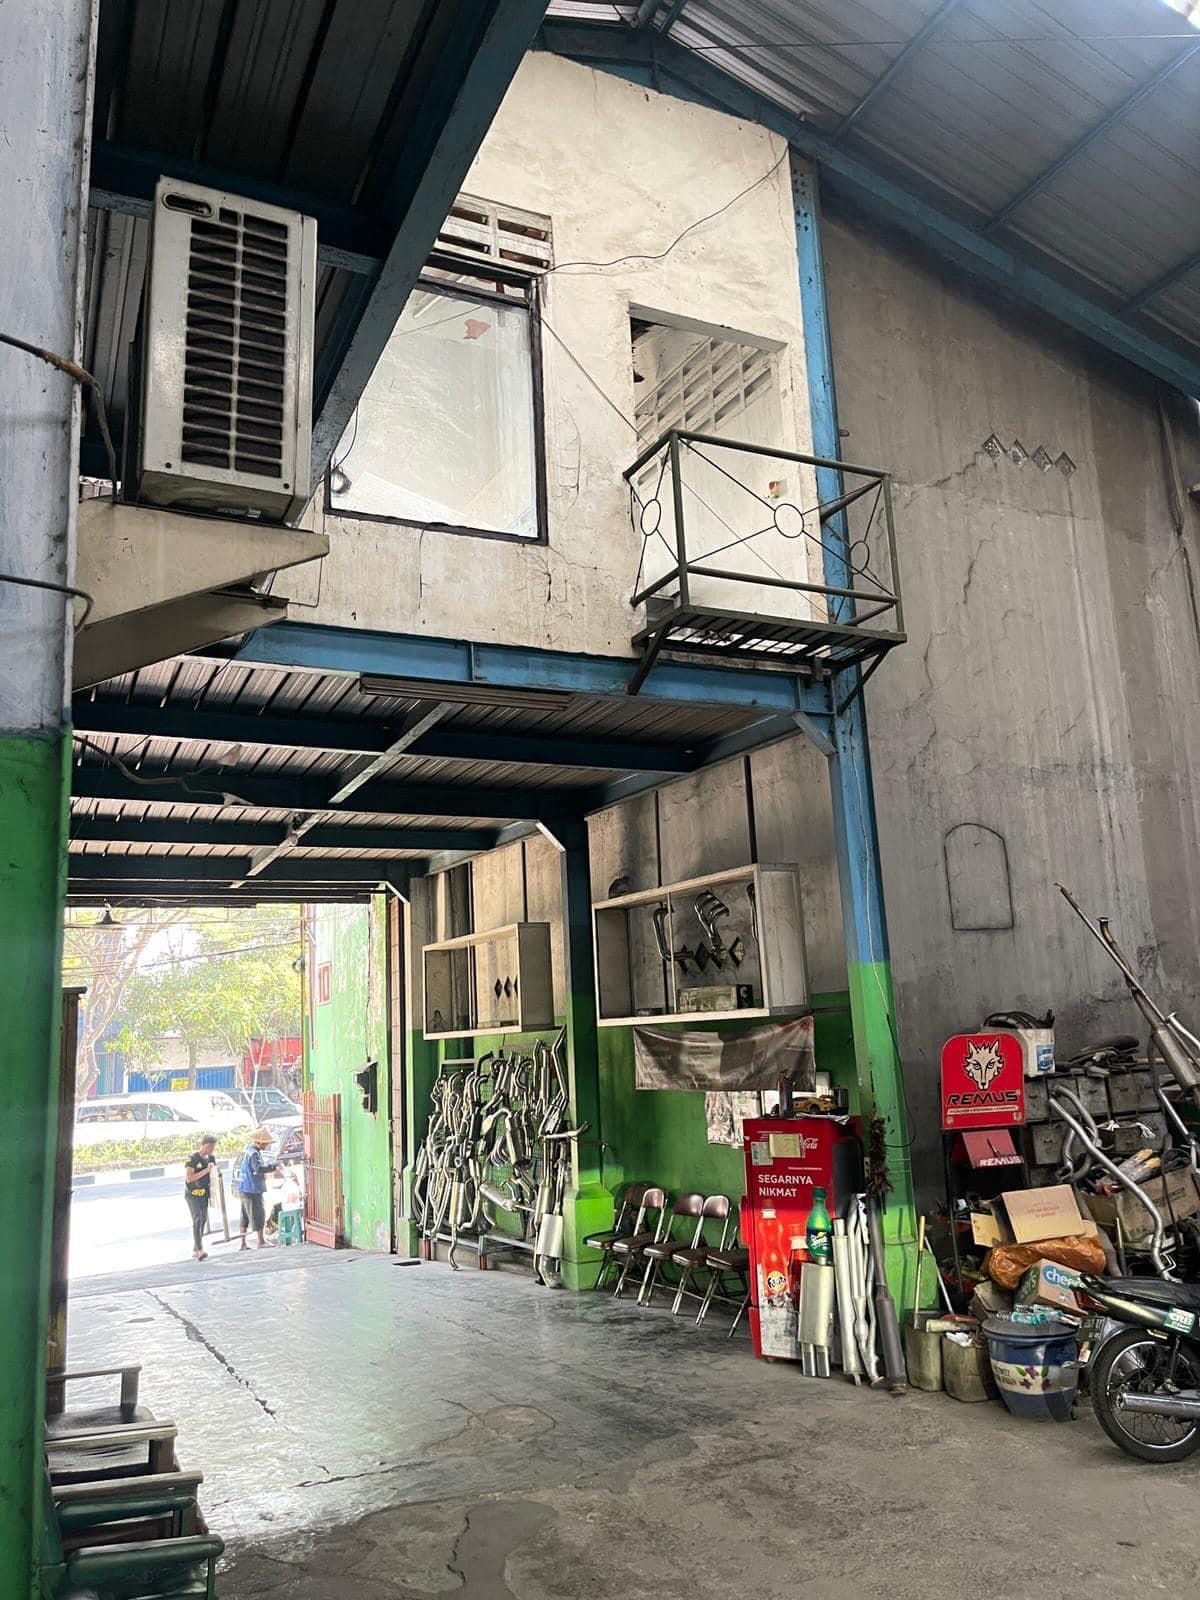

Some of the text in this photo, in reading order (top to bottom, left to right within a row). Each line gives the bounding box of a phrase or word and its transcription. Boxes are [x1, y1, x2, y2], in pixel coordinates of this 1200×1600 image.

[947, 1091, 1018, 1105] REMUS
[979, 1156, 1022, 1167] REMUS
[758, 1174, 813, 1185] SEGARNYA
[758, 1187, 798, 1197] NIKMAT
